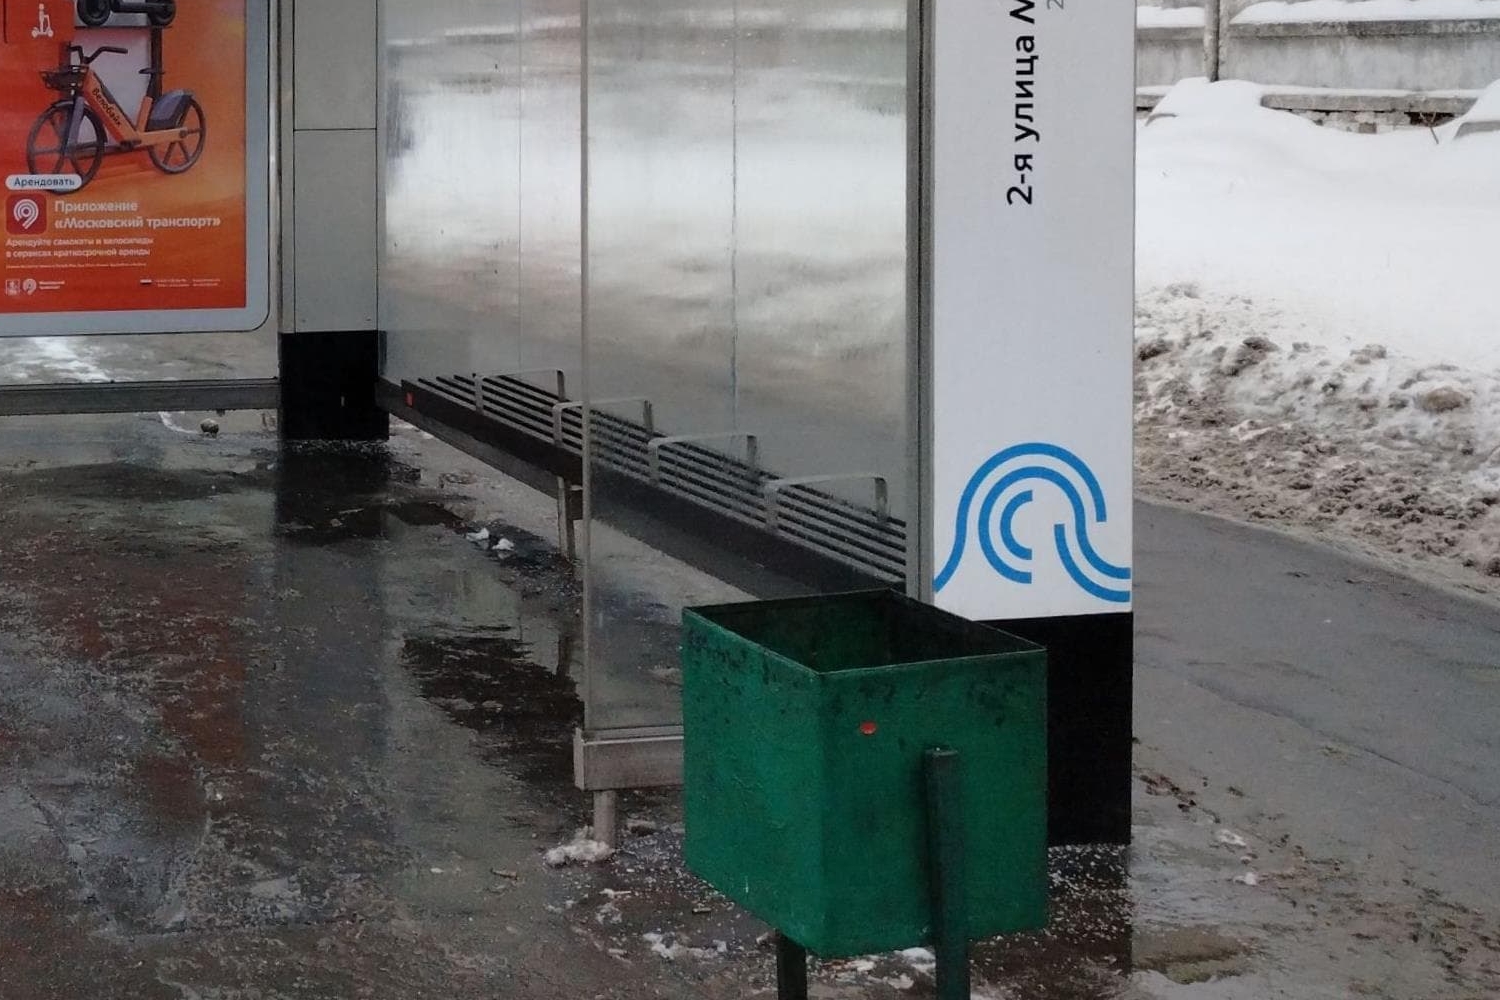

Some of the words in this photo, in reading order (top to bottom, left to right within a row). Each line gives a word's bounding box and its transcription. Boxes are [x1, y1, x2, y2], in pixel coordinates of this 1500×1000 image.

[1013, 34, 1040, 142] улица
[14, 177, 75, 187] Арендовать
[1006, 153, 1033, 205] 2-я
[55, 200, 138, 213] Приложение
[54, 215, 144, 229] «Московский
[147, 217, 221, 230] транспорт»
